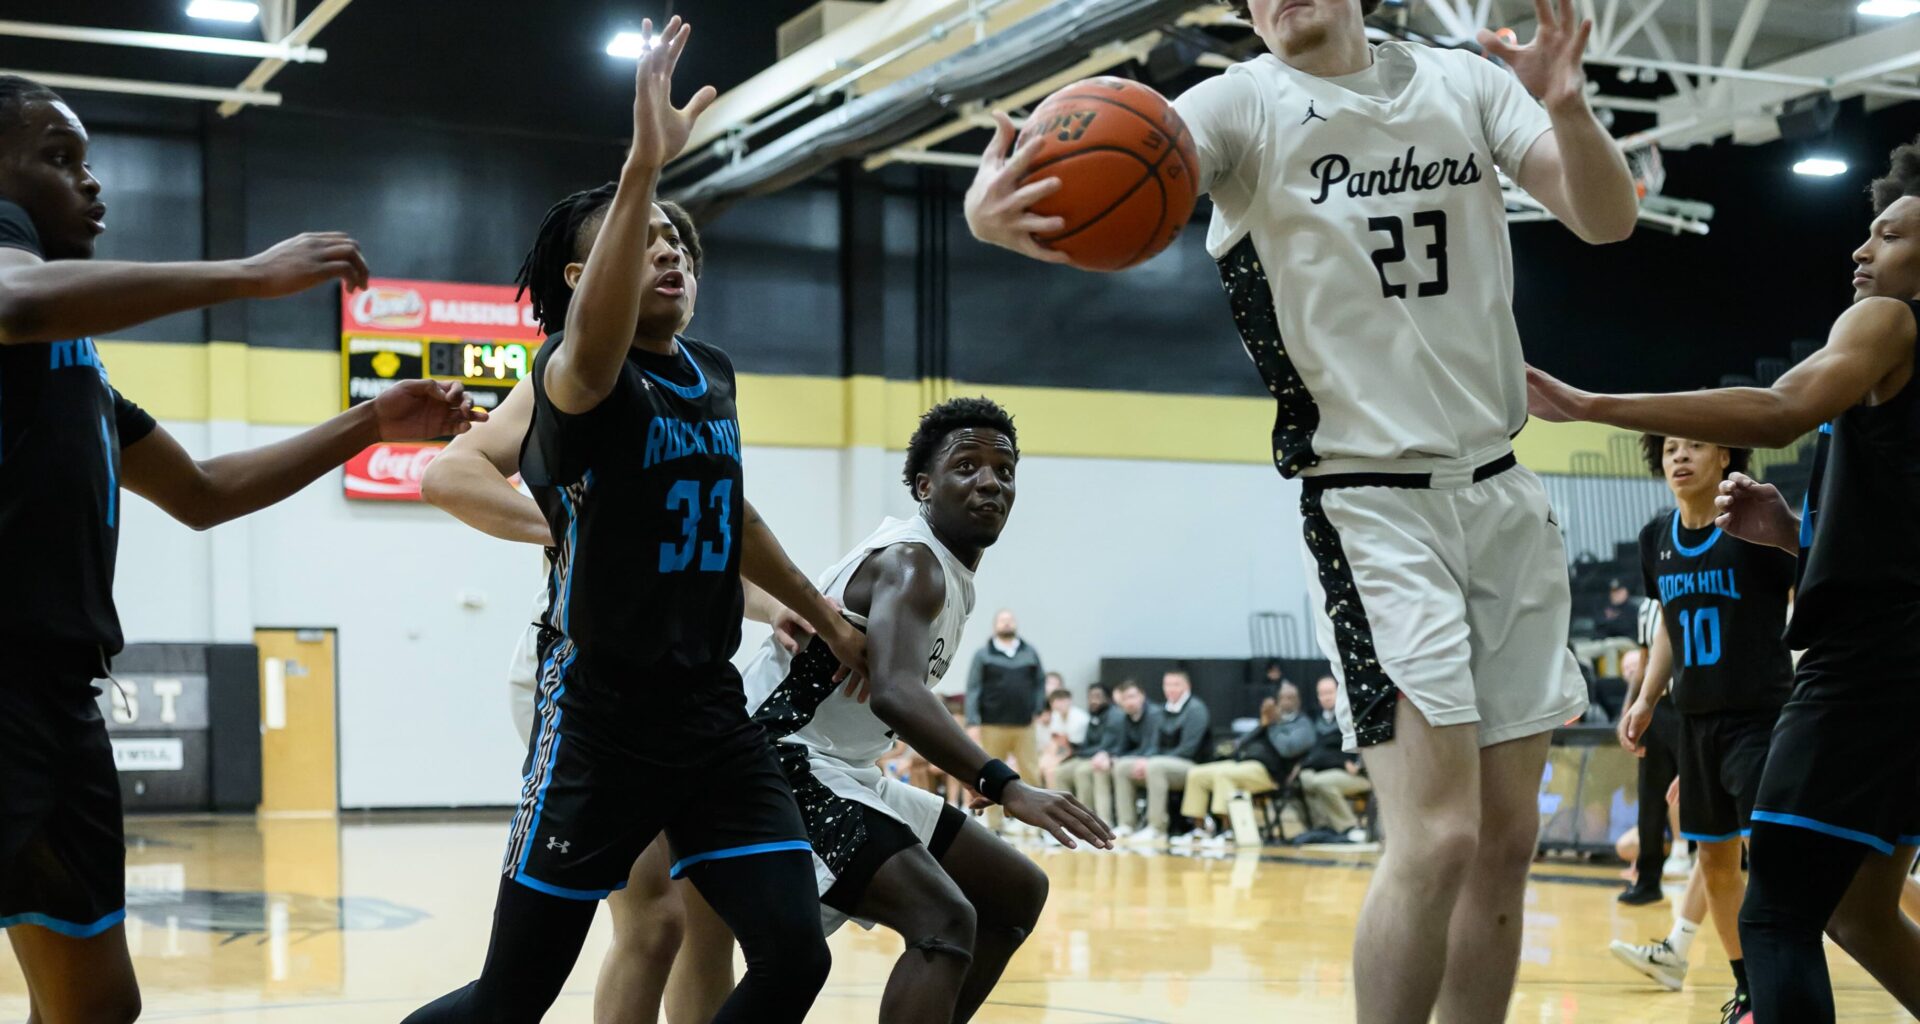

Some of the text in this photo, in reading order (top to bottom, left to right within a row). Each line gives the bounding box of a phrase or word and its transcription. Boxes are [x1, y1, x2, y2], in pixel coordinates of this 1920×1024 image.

[1310, 146, 1482, 205] Panthers
[1368, 210, 1449, 299] 23
[463, 343, 527, 381] 1:49
[643, 416, 708, 469] ROCK
[658, 478, 733, 573] 33
[1658, 568, 1741, 607] ROCK HILL
[1679, 607, 1722, 668] 10
